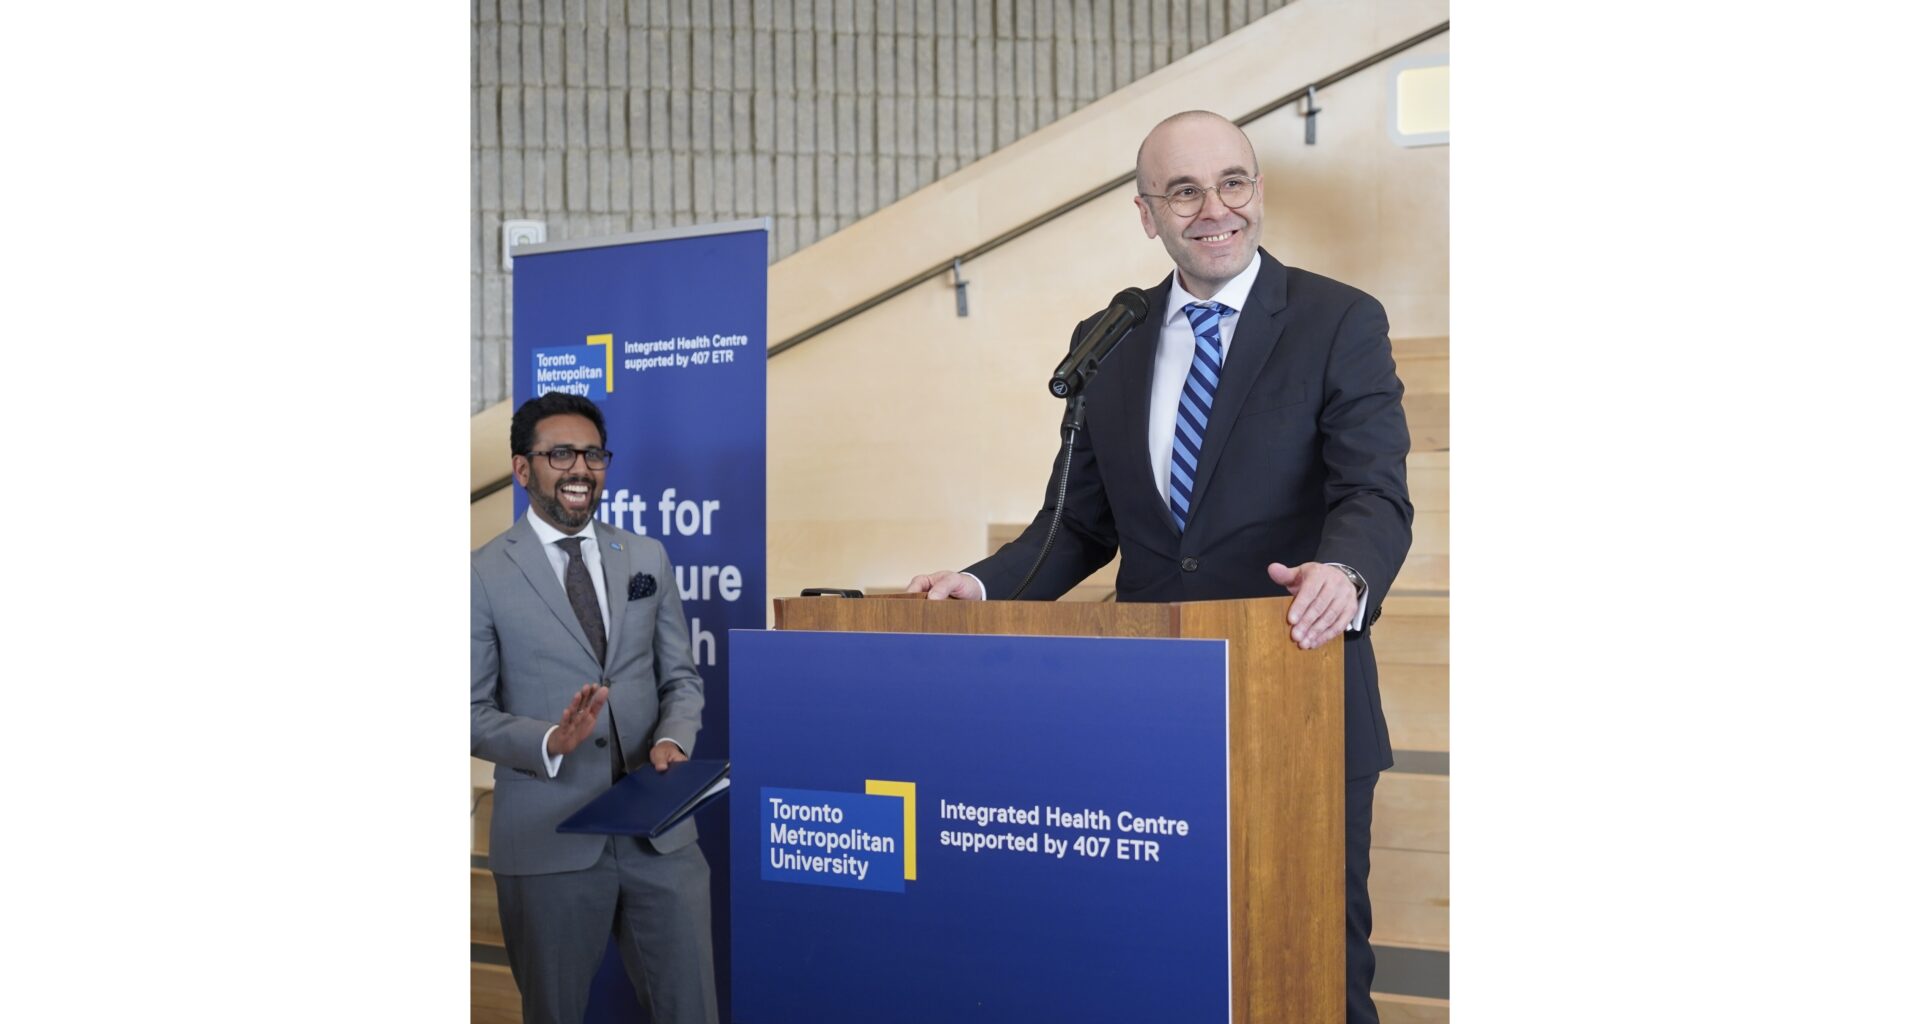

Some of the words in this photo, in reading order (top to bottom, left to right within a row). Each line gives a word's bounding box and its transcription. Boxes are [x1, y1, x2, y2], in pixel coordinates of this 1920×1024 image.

[536, 353, 577, 367] Toronto
[624, 337, 675, 356] Integrated
[677, 335, 710, 350] Health
[712, 334, 748, 348] Centre
[624, 353, 674, 371] supported
[676, 353, 689, 368] by
[691, 351, 710, 365] 407
[712, 350, 734, 364] ETR
[537, 365, 603, 384] Metropolitan
[594, 489, 647, 536] ift
[658, 488, 720, 536] for
[672, 565, 742, 602] ure
[769, 797, 843, 824] Toronto
[940, 799, 1040, 827] Integrated
[1046, 806, 1111, 831] Health
[1117, 810, 1190, 837] Centre
[770, 822, 895, 854] Metropolitan
[940, 830, 1038, 853] supported
[1044, 833, 1068, 859] by
[1072, 835, 1111, 858] 407
[1116, 838, 1160, 862] ETR
[770, 847, 869, 881] University
